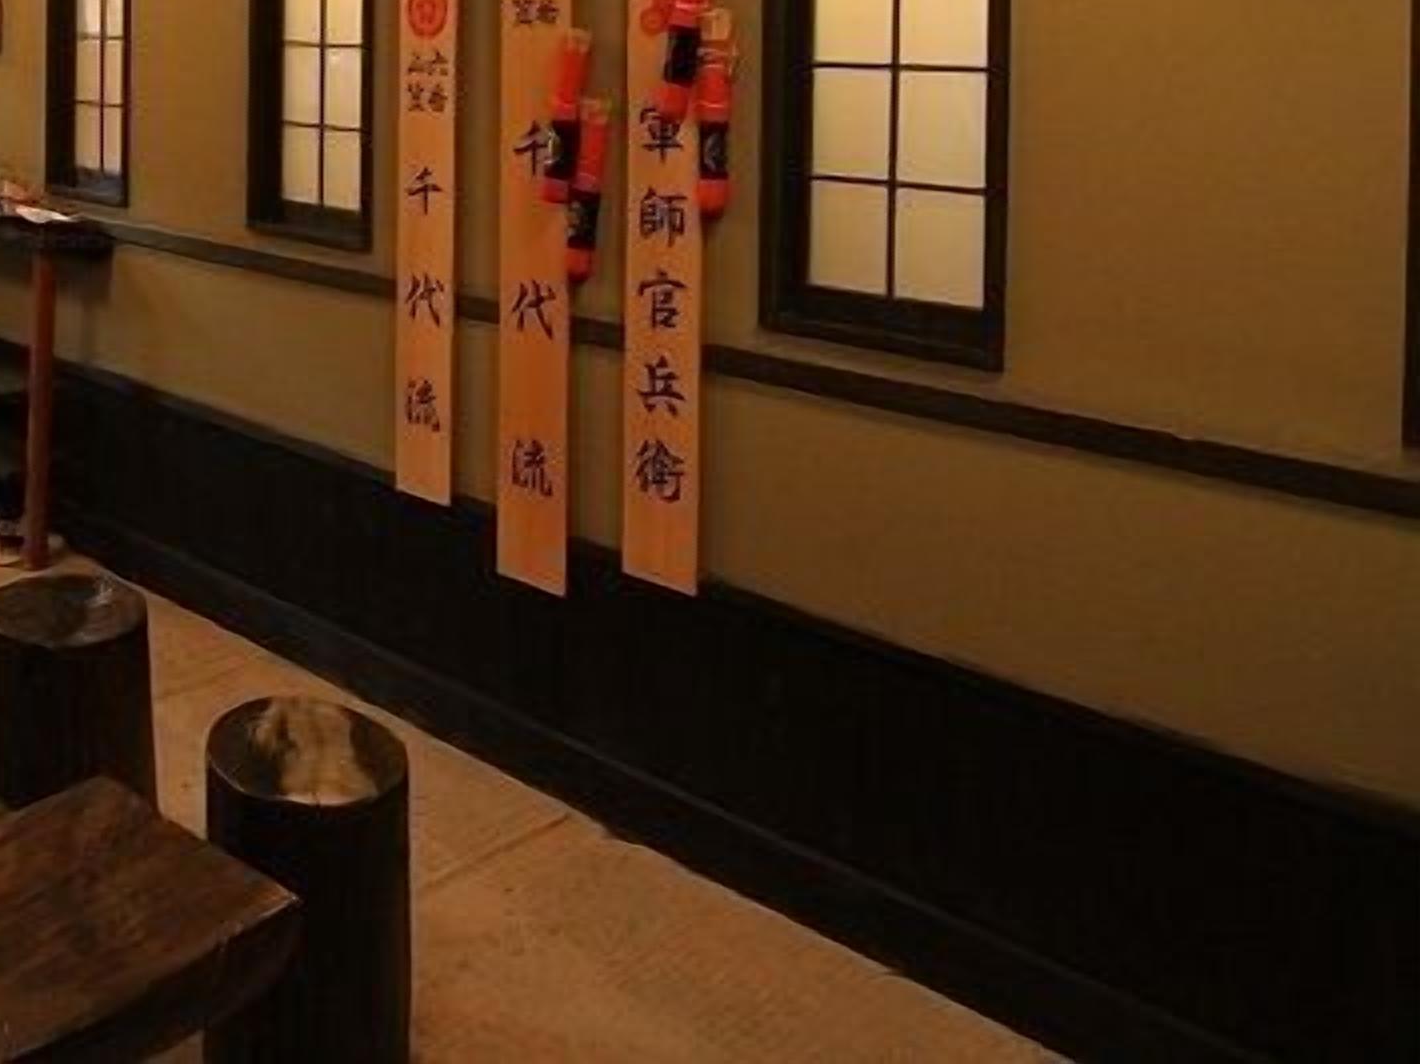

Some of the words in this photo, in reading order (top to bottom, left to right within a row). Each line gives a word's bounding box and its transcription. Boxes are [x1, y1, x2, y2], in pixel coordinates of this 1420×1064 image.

[405, 166, 446, 433] 千代流
[511, 119, 557, 498] 千代流
[635, 107, 687, 503] 軍師官兵衛
